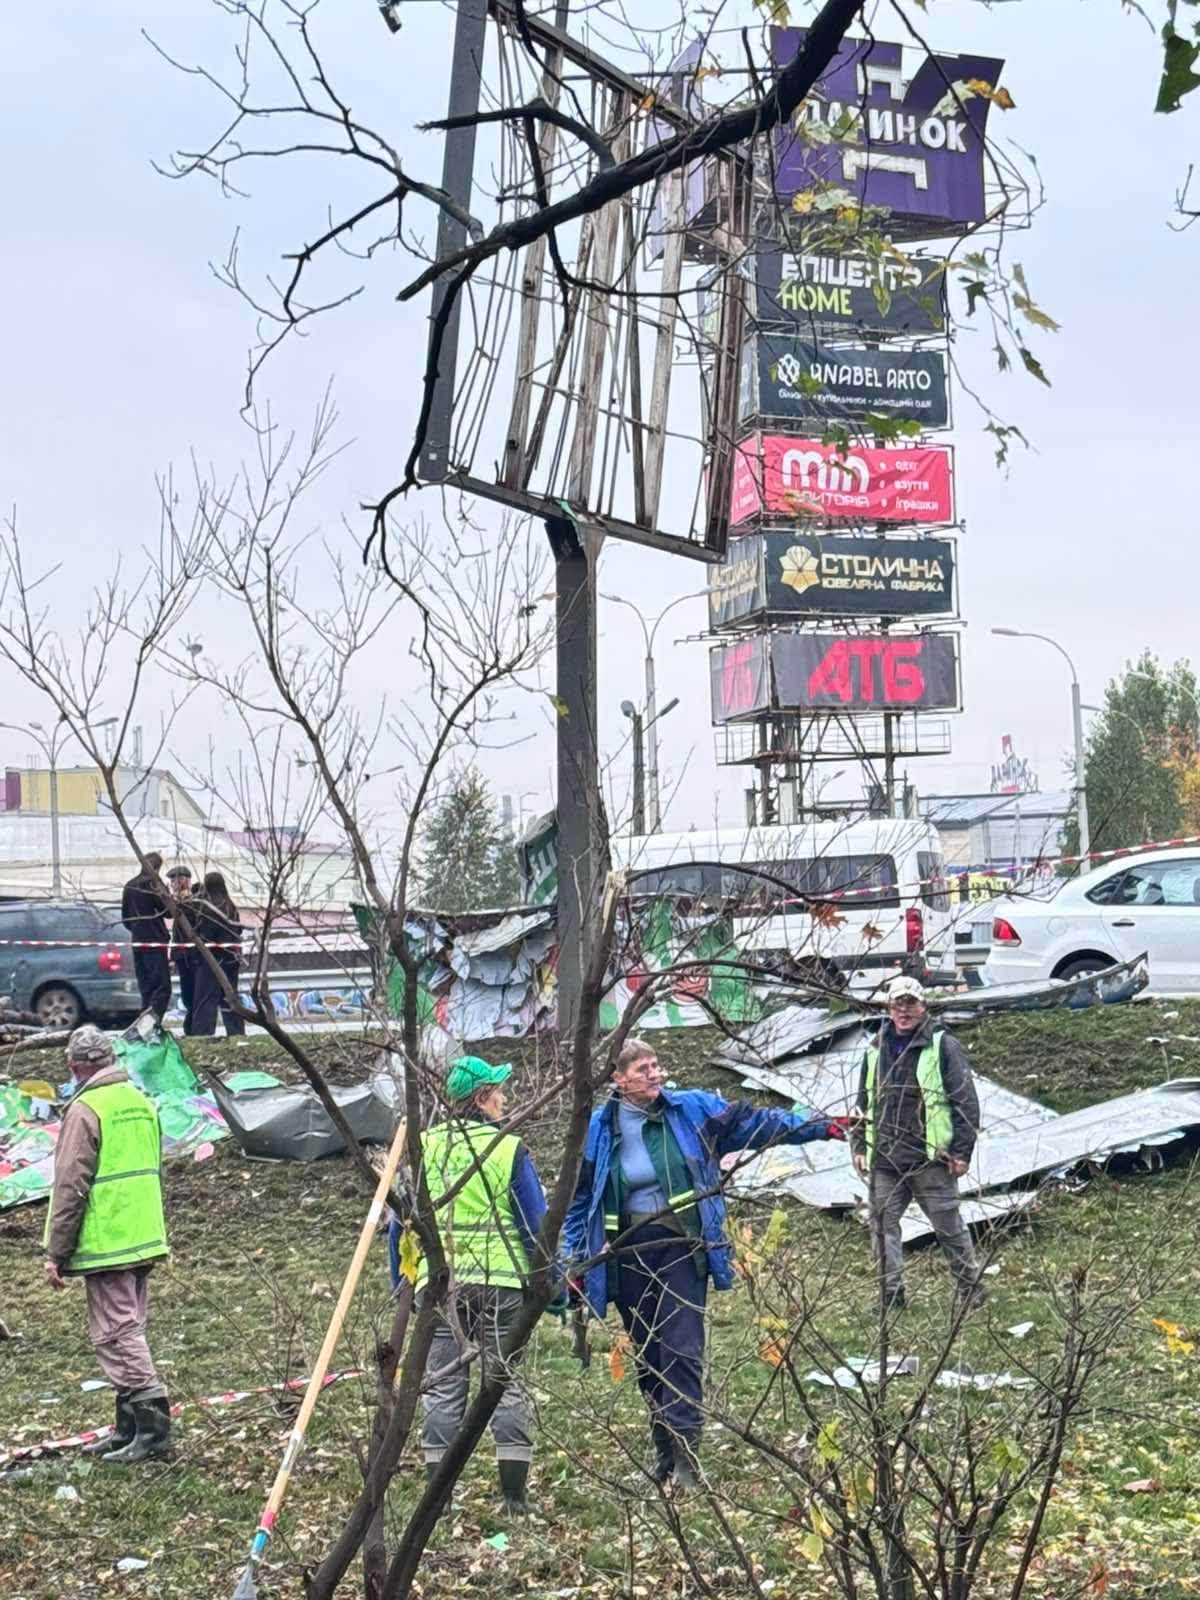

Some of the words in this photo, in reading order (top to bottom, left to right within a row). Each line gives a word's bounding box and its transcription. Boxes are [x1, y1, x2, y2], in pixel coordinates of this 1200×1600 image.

[782, 284, 854, 316] HOME
[886, 368, 932, 391] ARTO
[782, 448, 870, 494] min
[821, 552, 944, 580] СТОЛИЧНА
[822, 577, 886, 591] ЮВЕЛІРНА
[890, 579, 944, 593] ФАБРИКА
[808, 640, 925, 703] АТБ
